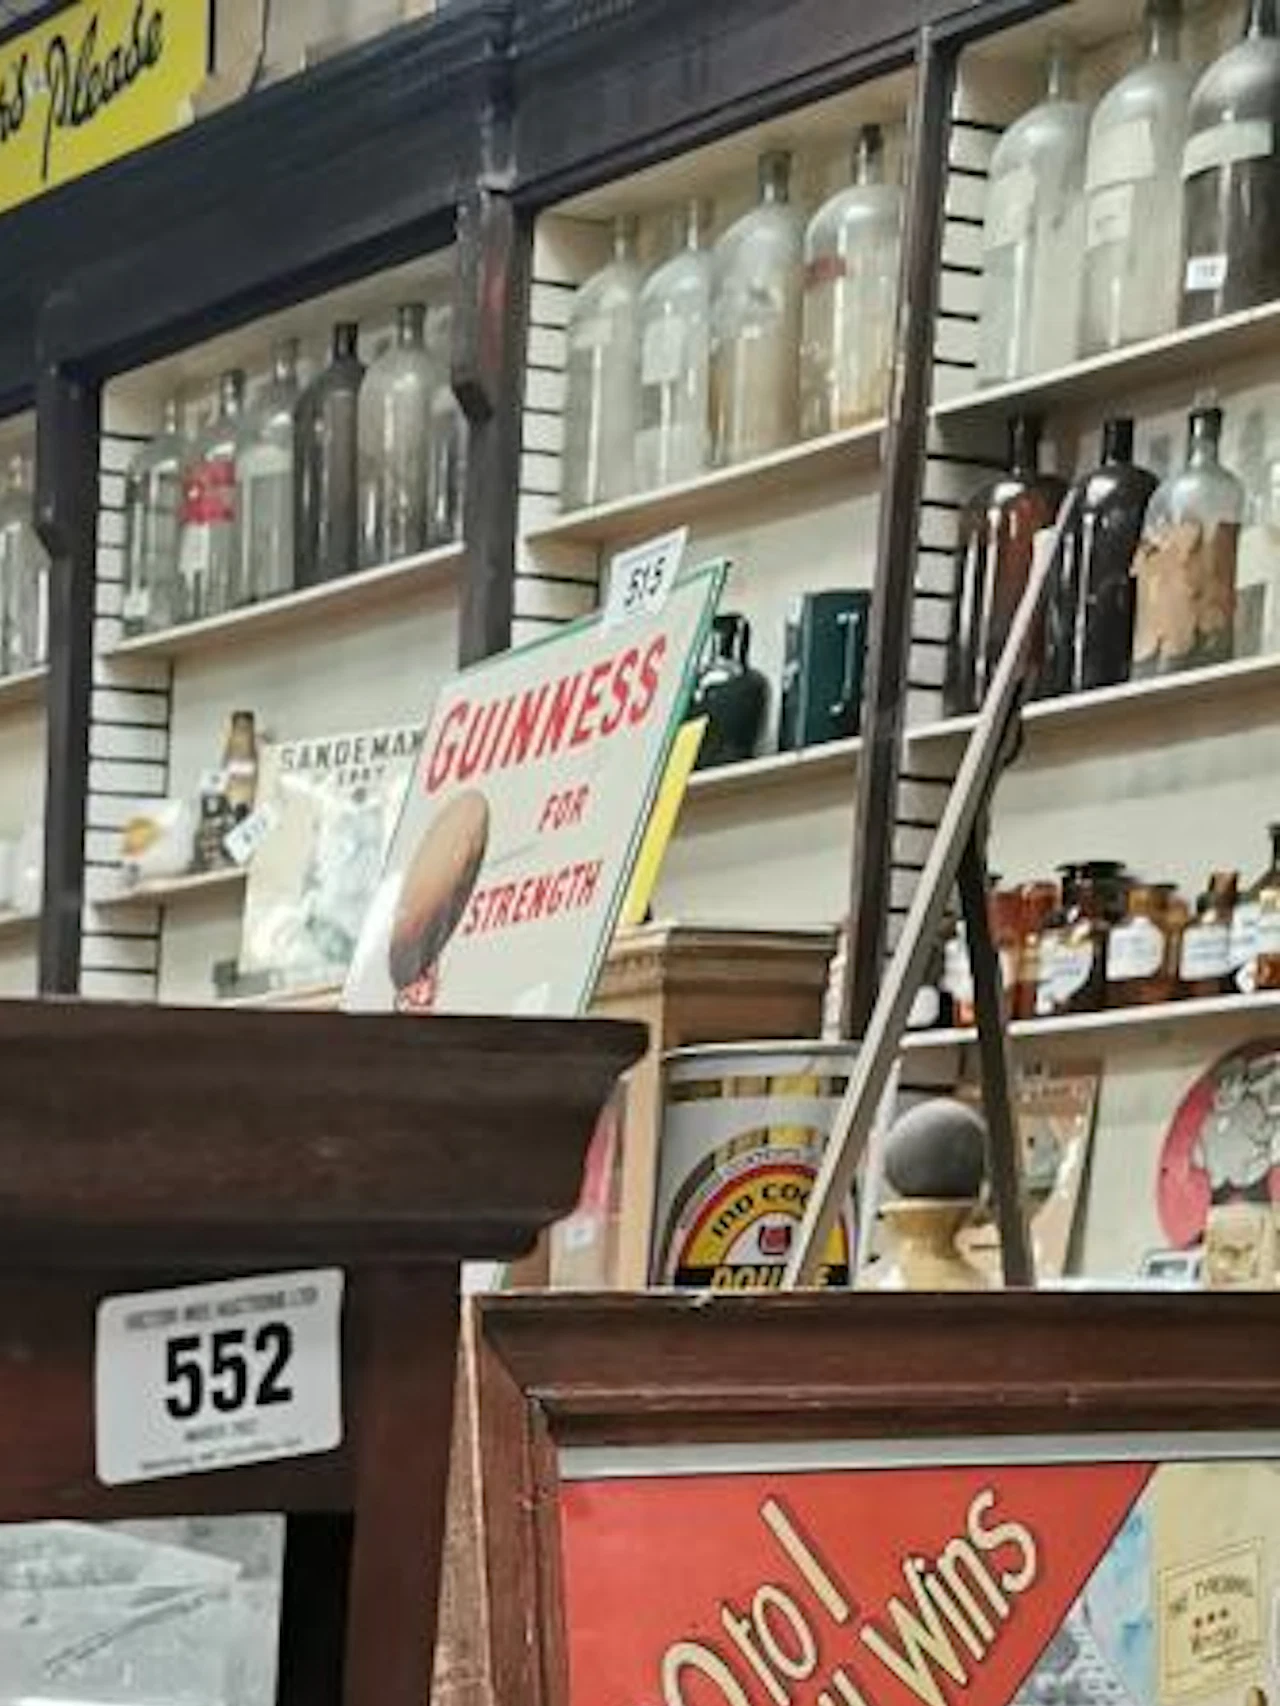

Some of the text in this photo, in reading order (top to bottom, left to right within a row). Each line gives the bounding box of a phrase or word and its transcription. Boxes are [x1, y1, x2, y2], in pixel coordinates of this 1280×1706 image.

[42, 0, 164, 182] Please
[625, 556, 666, 607] 515
[427, 634, 667, 795] GUINNESS
[539, 784, 590, 833] FOR
[461, 859, 604, 937] STRENGTH
[166, 1321, 294, 1419] 552
